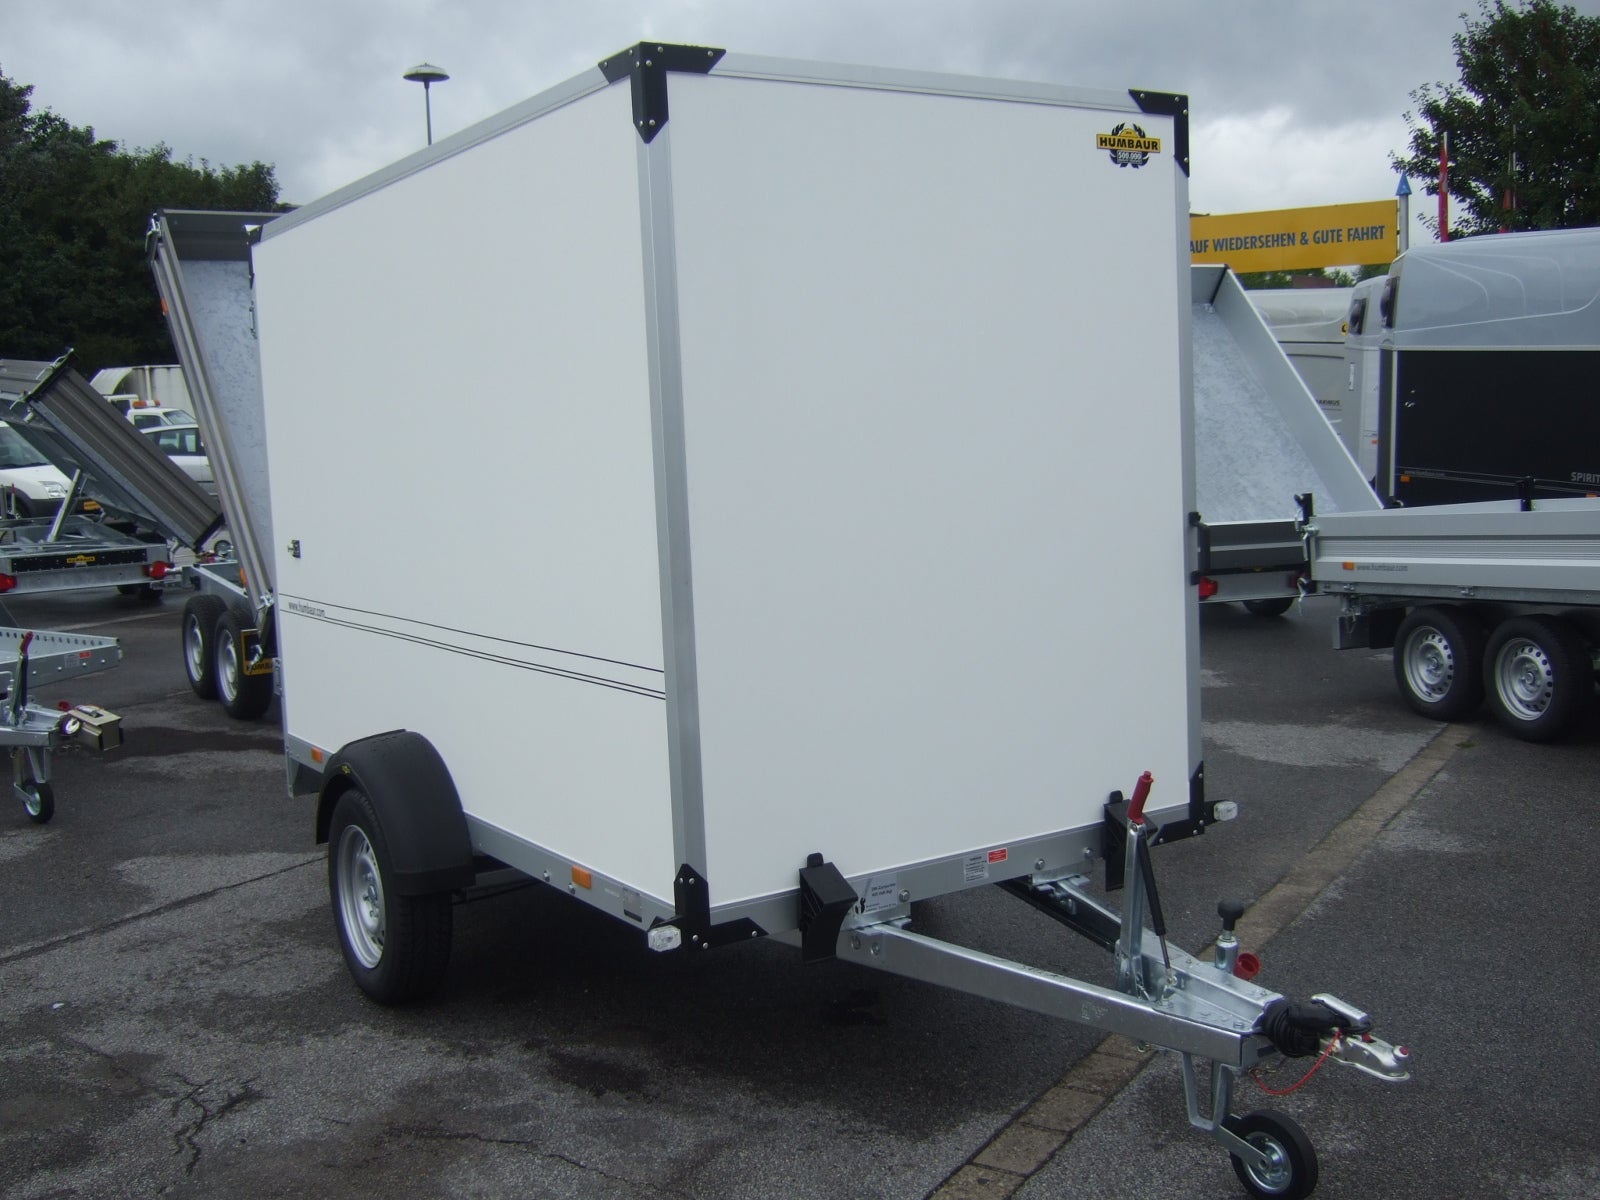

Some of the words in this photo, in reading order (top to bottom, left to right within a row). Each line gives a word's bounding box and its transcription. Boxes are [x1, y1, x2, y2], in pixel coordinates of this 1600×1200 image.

[1099, 136, 1158, 150] HUMBAUR
[1190, 240, 1209, 253] AUF
[1212, 233, 1295, 252] WIEDERSEHEN
[1300, 231, 1309, 245] &
[1313, 228, 1343, 244] GUTE
[1347, 225, 1385, 242] FAHRT
